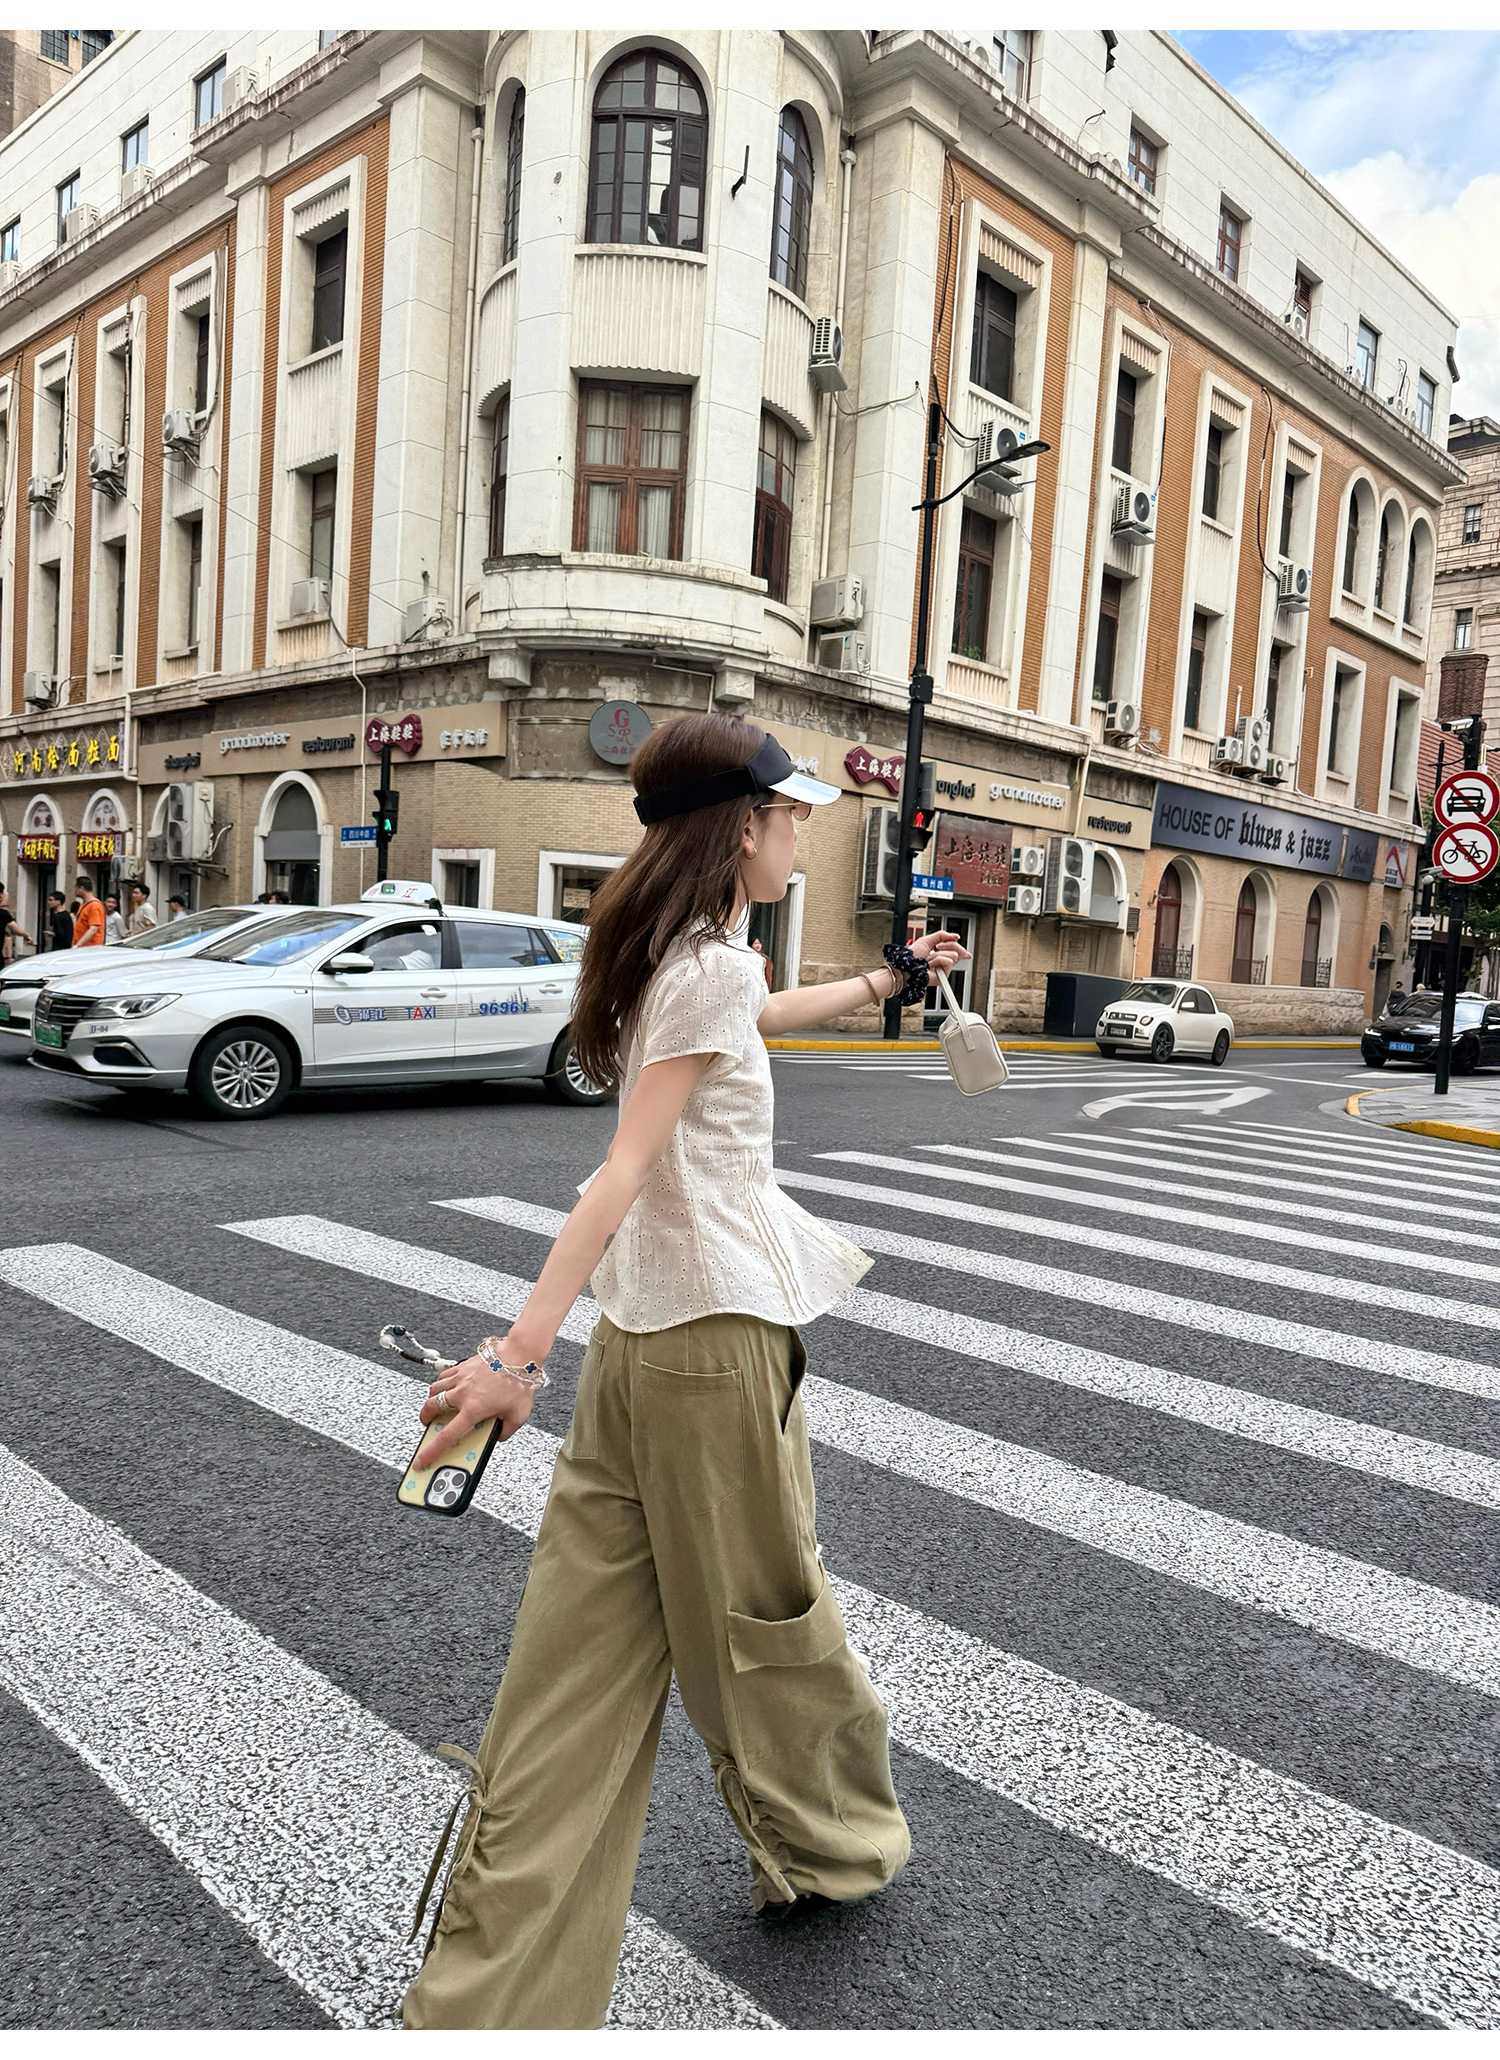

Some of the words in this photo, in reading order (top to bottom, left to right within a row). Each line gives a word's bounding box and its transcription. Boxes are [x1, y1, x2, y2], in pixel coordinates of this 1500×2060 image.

[219, 731, 291, 755] grandmother
[301, 733, 356, 753] restaurant
[936, 780, 976, 800] anghai
[990, 783, 1065, 808] grandmother
[1087, 815, 1133, 834] restaurant
[1159, 804, 1212, 840] HOUSE
[1214, 816, 1235, 840] OF
[1238, 810, 1282, 852] blues
[1285, 829, 1296, 854] &
[1299, 828, 1332, 864] jazz
[405, 1006, 437, 1019] TAXI
[479, 1001, 529, 1016] 96961
